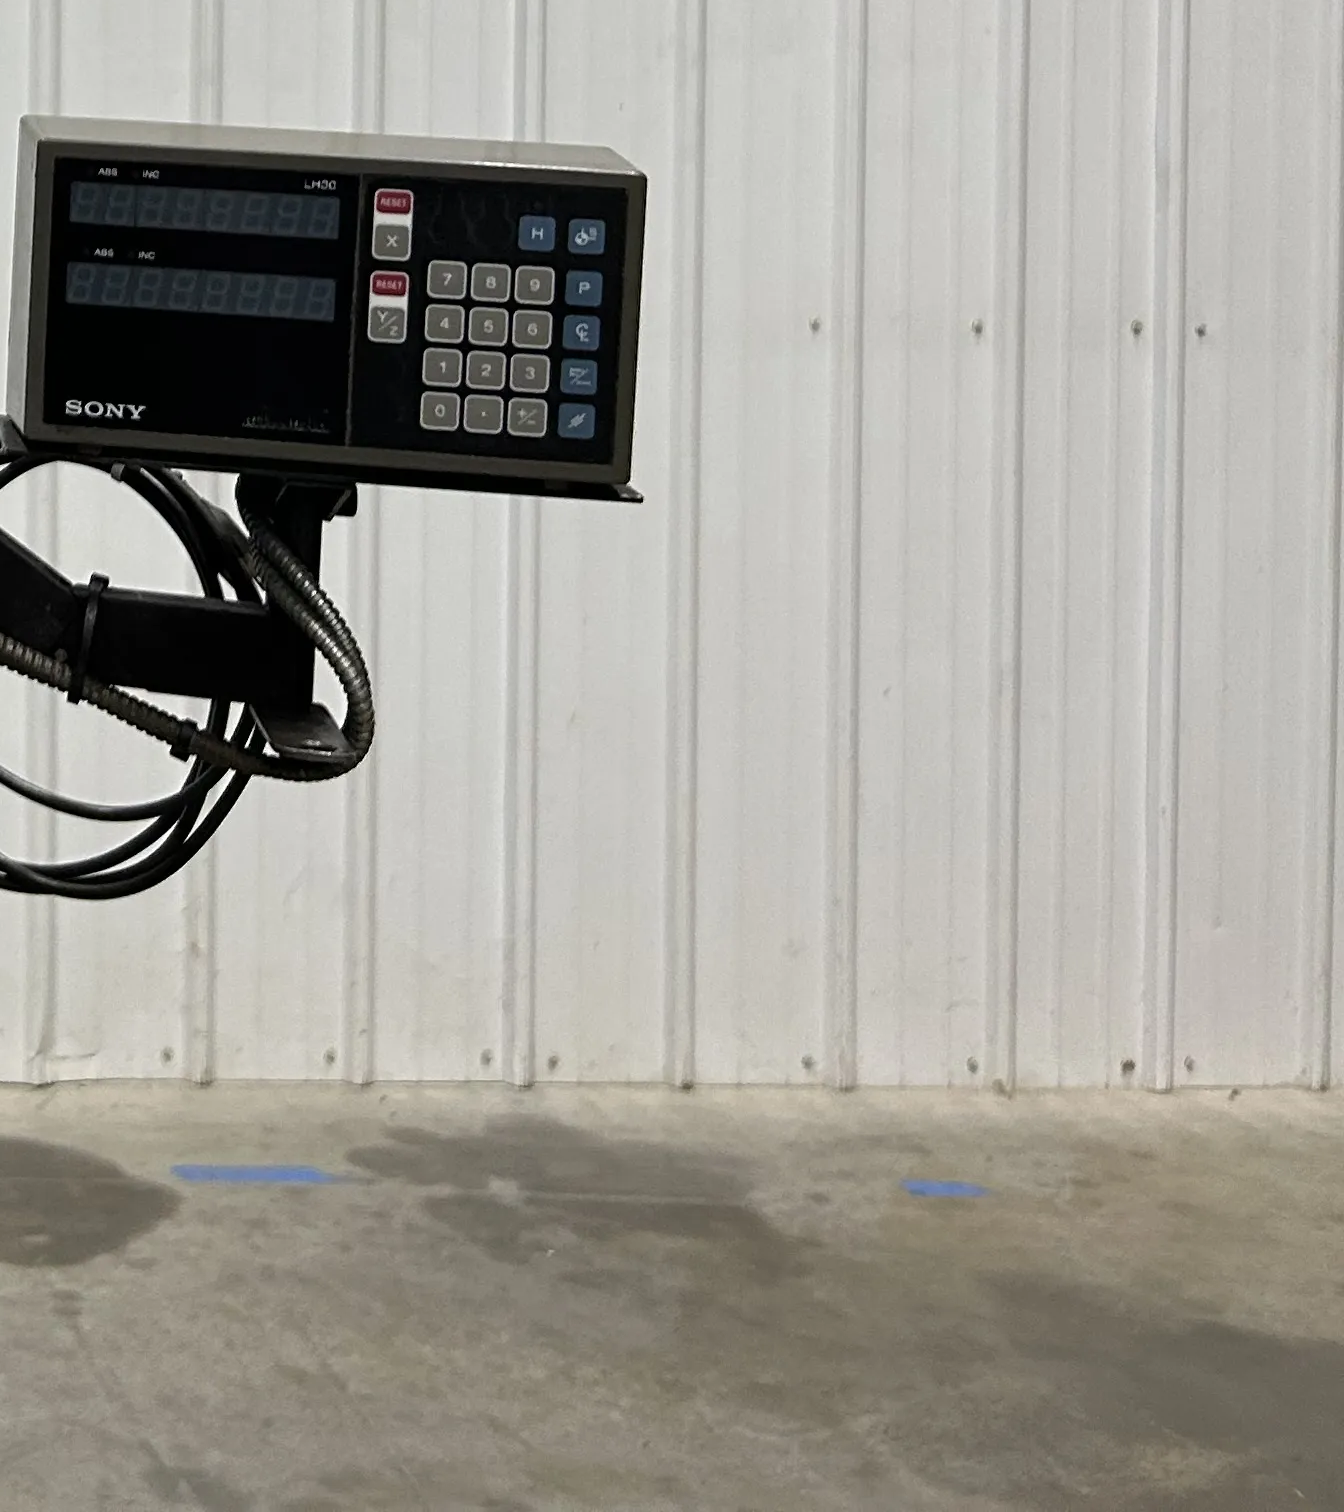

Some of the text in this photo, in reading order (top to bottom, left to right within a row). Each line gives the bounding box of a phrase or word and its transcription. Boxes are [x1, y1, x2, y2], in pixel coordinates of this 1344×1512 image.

[98, 167, 118, 177] ABS
[386, 235, 397, 248] X
[93, 248, 155, 260] ABS INC
[442, 272, 453, 286] 7
[485, 276, 496, 289] 8
[529, 278, 540, 292] 9
[578, 281, 591, 294] P
[439, 317, 449, 330] 4
[484, 320, 494, 334] 5
[527, 323, 538, 336] 6
[439, 361, 447, 374] 1
[481, 364, 492, 377] 2
[525, 366, 535, 380] 3
[65, 399, 146, 420] SONY
